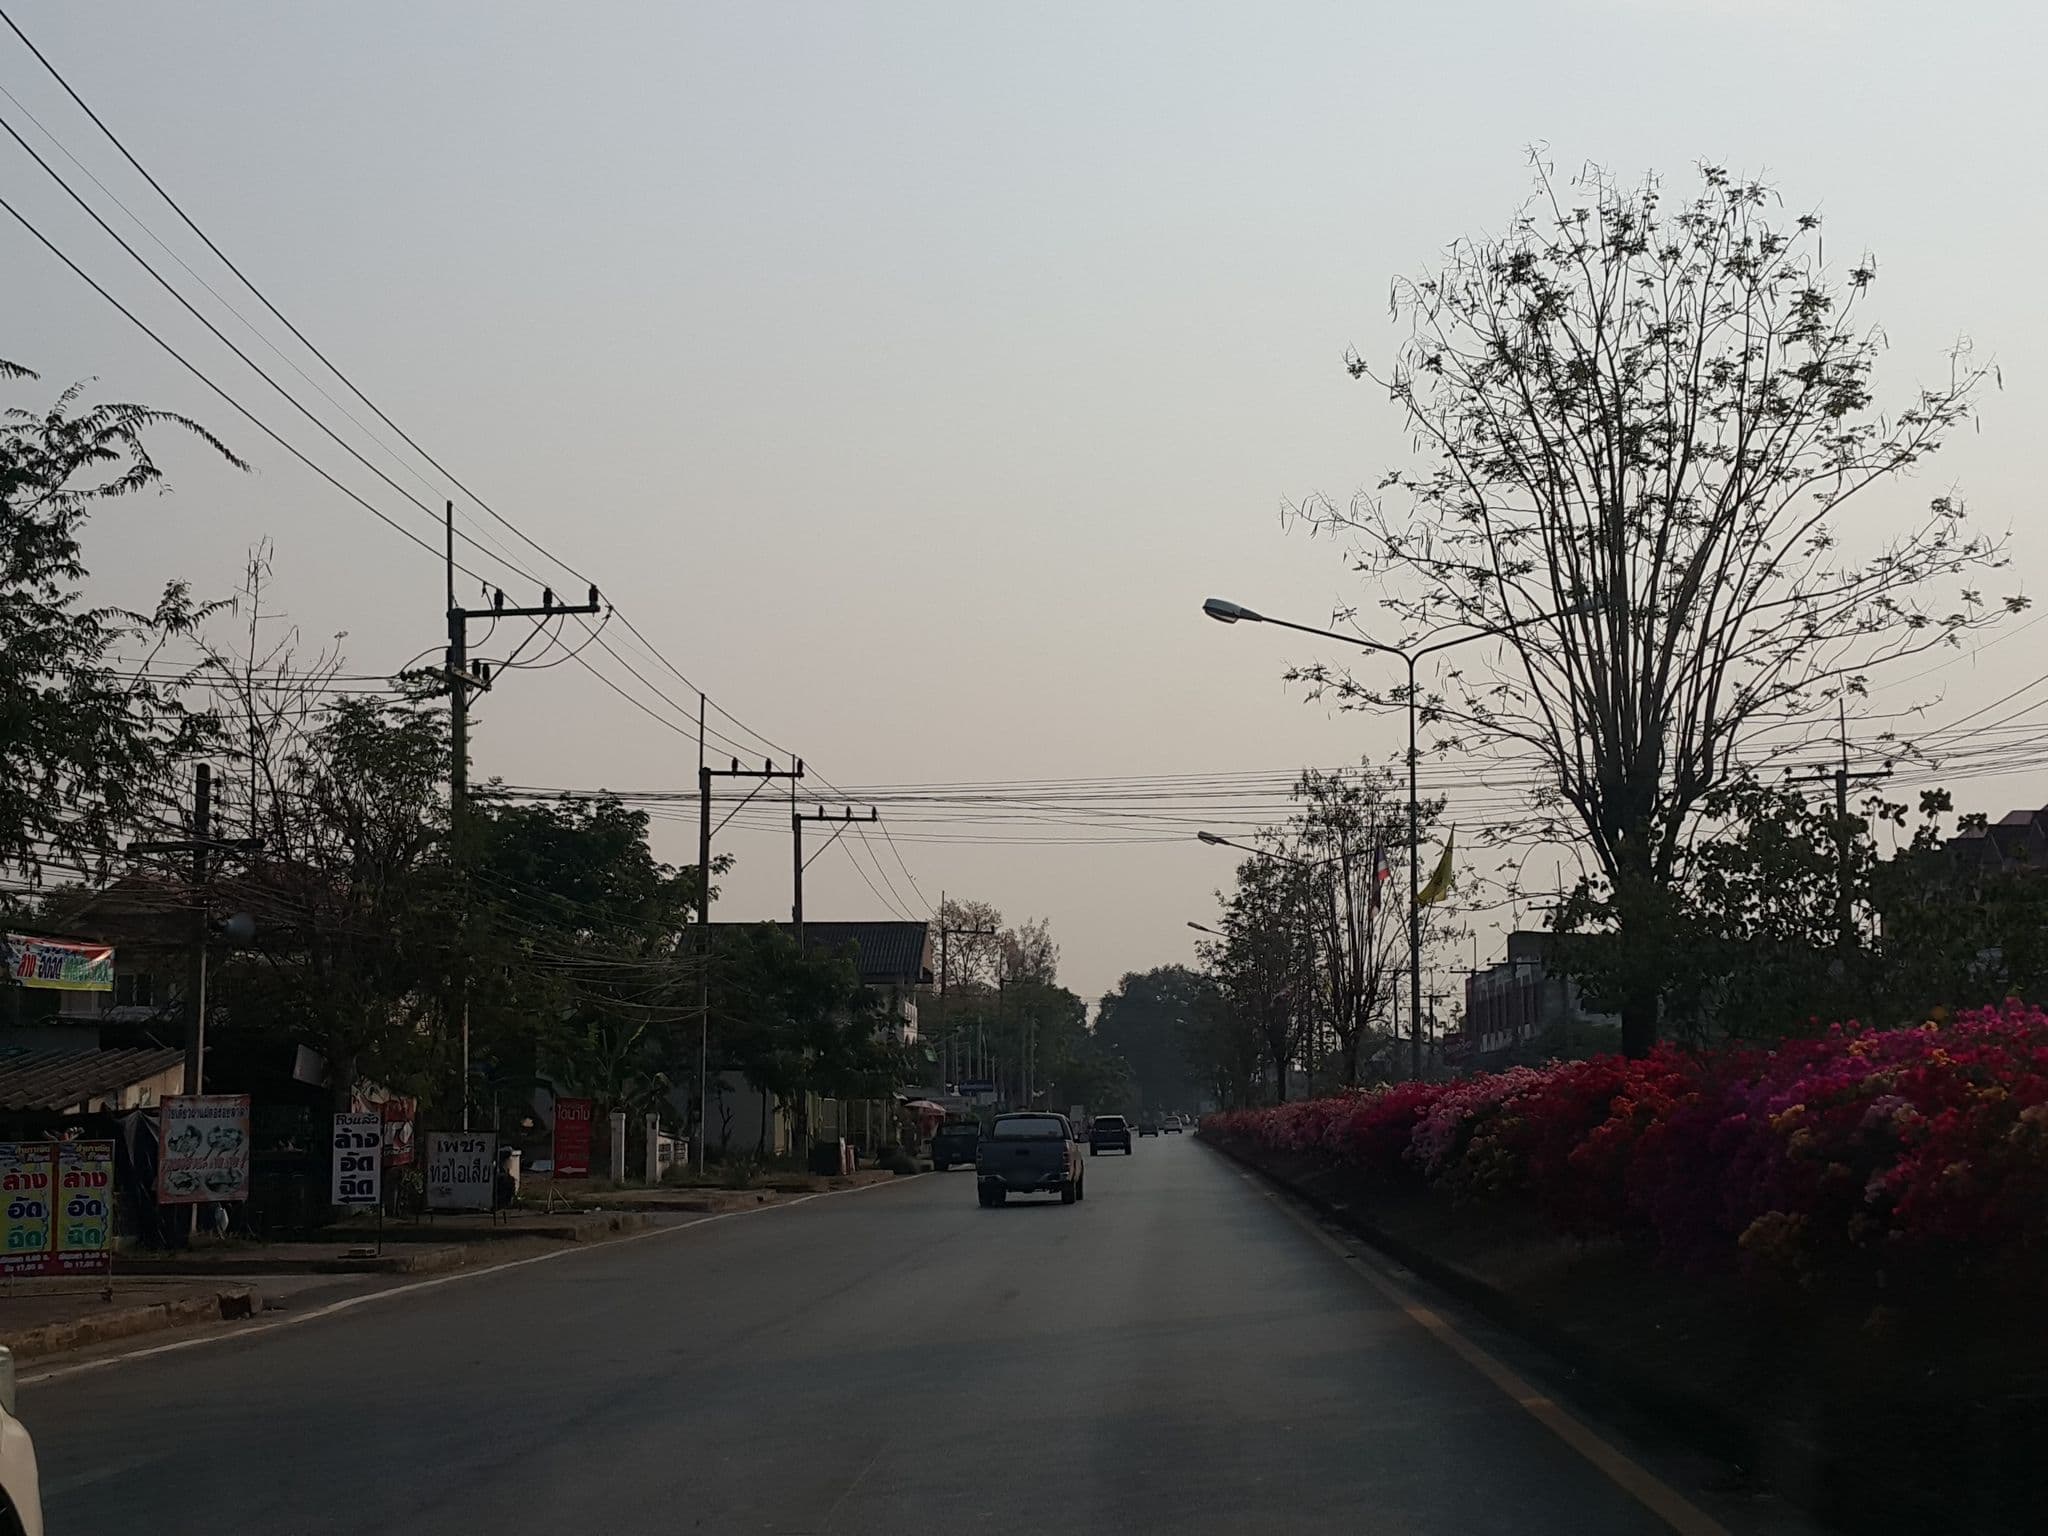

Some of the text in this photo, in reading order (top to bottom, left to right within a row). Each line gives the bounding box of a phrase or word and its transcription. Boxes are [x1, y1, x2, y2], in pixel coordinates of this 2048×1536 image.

[334, 1128, 380, 1149] ล้าง
[437, 1139, 486, 1153] เพชร
[340, 1152, 374, 1172] อัด
[430, 1158, 491, 1183] ท่อไอเสีย
[3, 1168, 48, 1191] ล้าง
[64, 1166, 108, 1188] ล้าง
[8, 1196, 43, 1219] อัด
[67, 1194, 102, 1217] อัด
